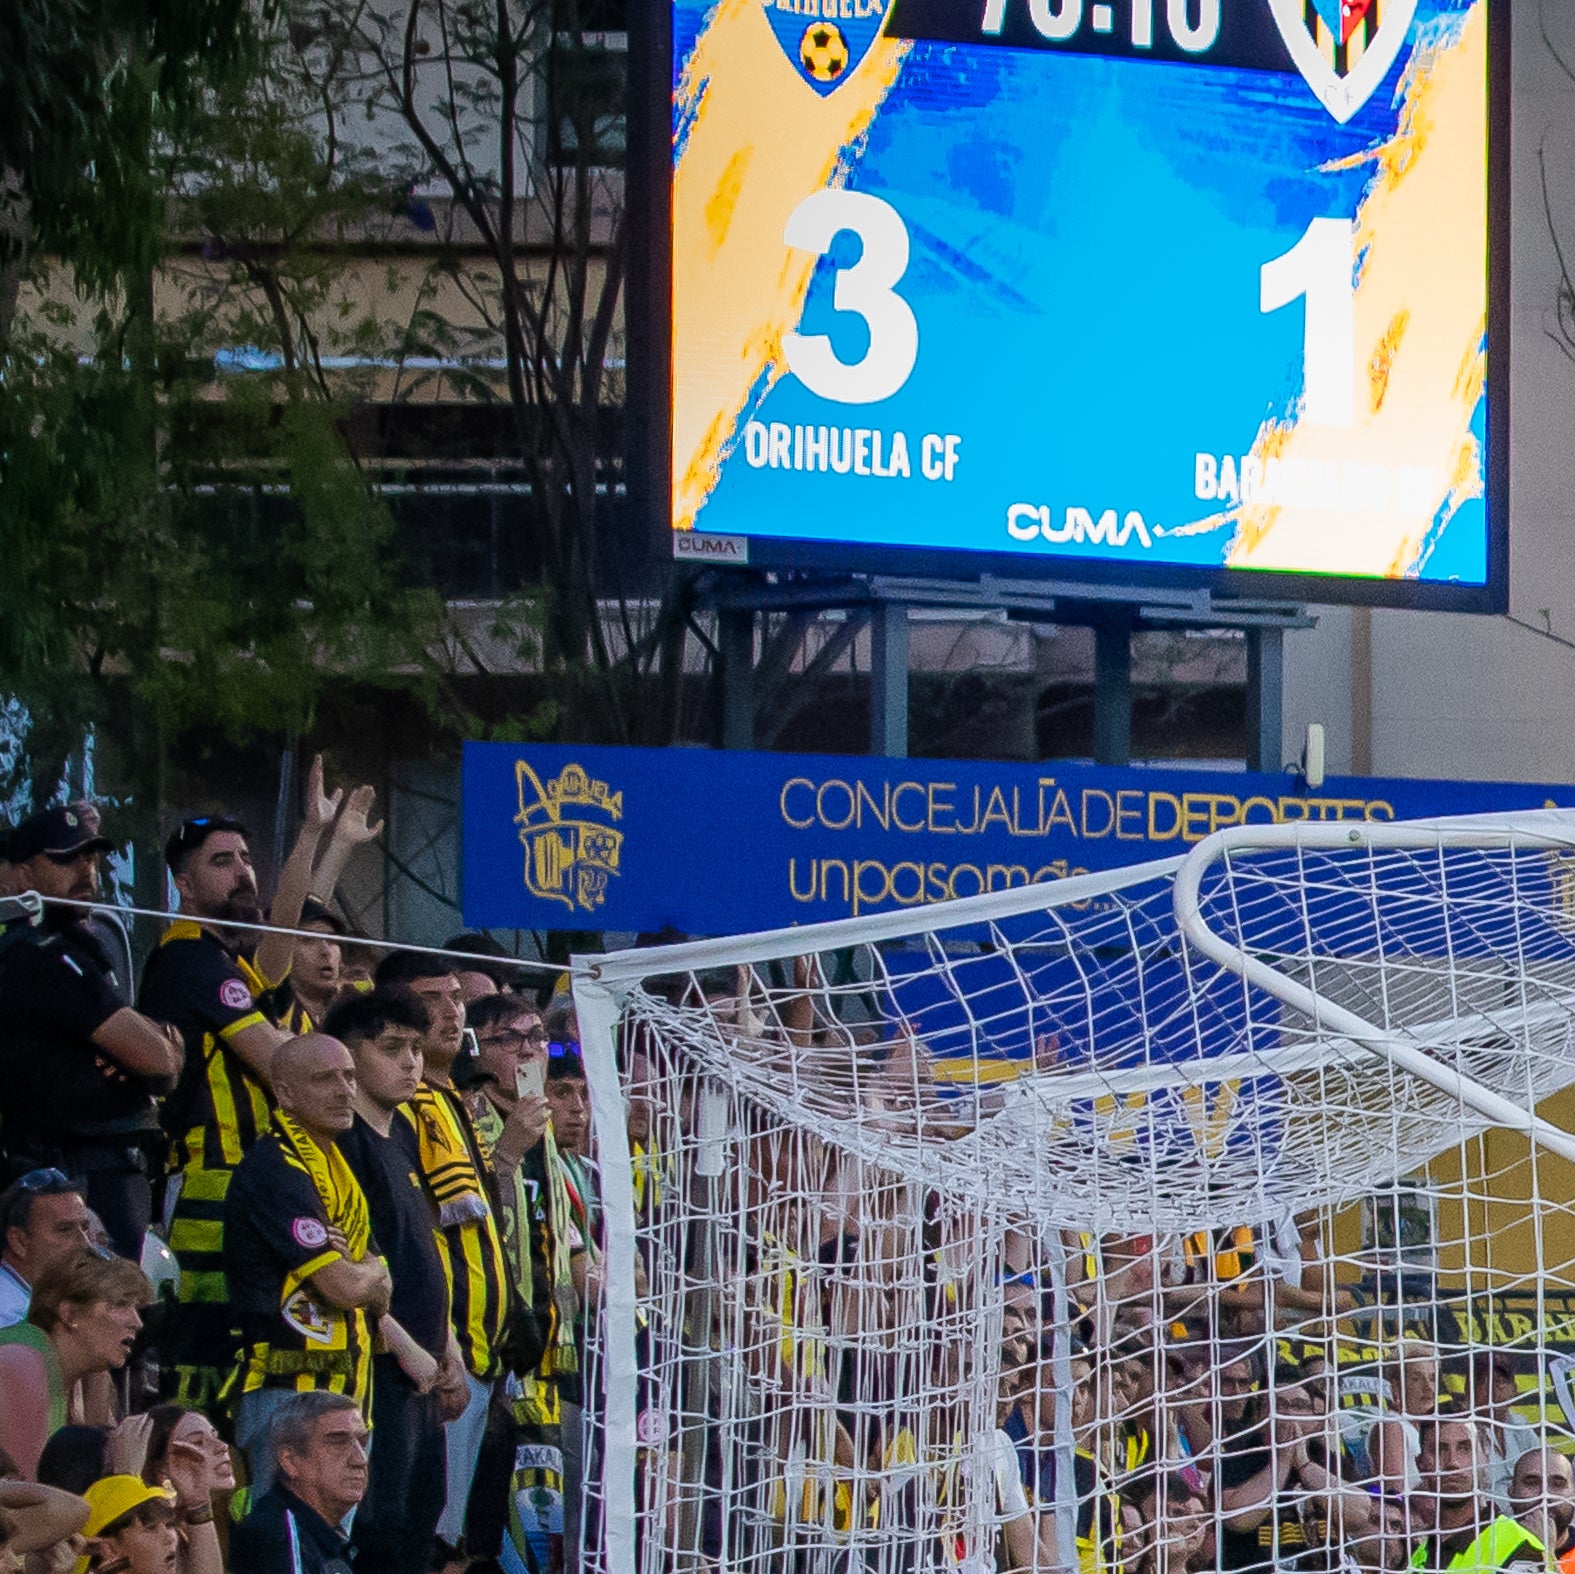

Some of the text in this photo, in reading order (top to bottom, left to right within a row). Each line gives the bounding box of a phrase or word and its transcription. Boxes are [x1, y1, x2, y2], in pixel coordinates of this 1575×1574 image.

[782, 187, 919, 404] 3
[1259, 216, 1357, 427] 1
[745, 420, 962, 481] ORIHUELA CF
[1007, 503, 1152, 548] CUMA
